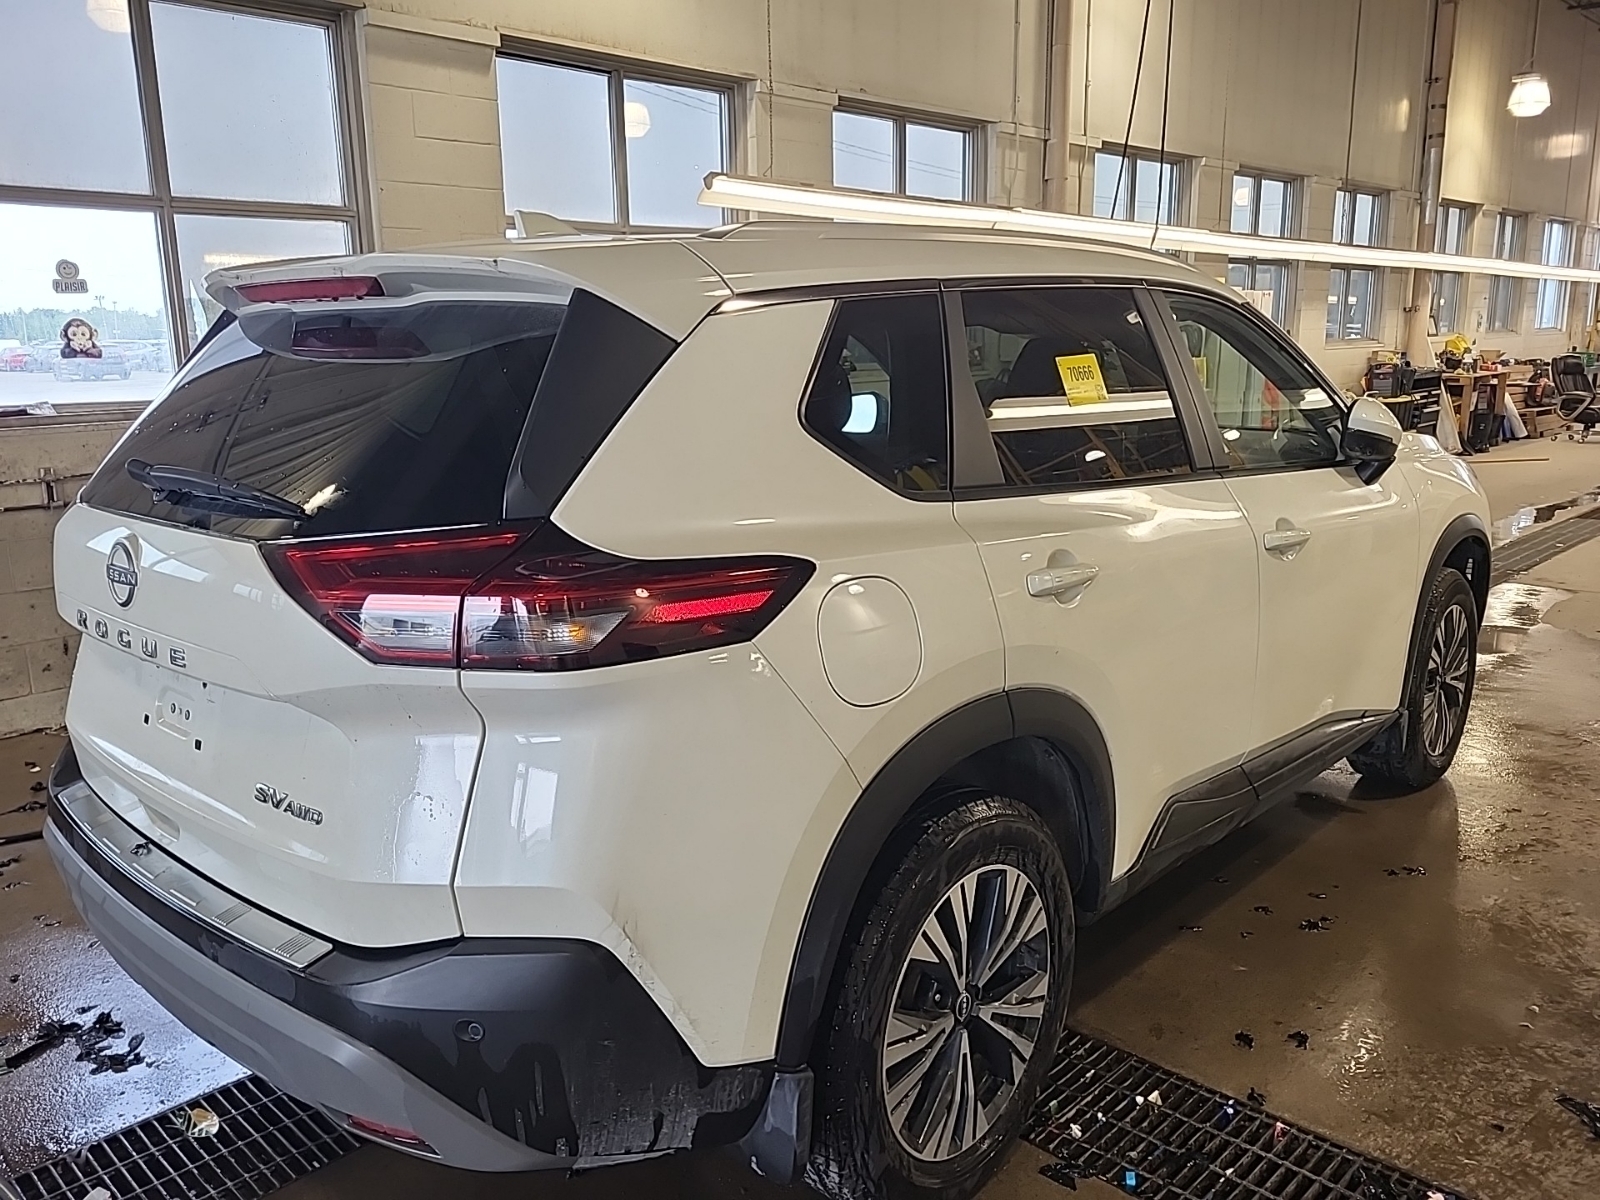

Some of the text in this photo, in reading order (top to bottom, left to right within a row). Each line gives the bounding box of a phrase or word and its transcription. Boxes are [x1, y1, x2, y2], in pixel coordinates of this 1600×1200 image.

[55, 281, 86, 292] PLAISIR
[1066, 365, 1095, 382] 70666
[108, 569, 135, 585] SSAN
[77, 609, 187, 668] ROGUE
